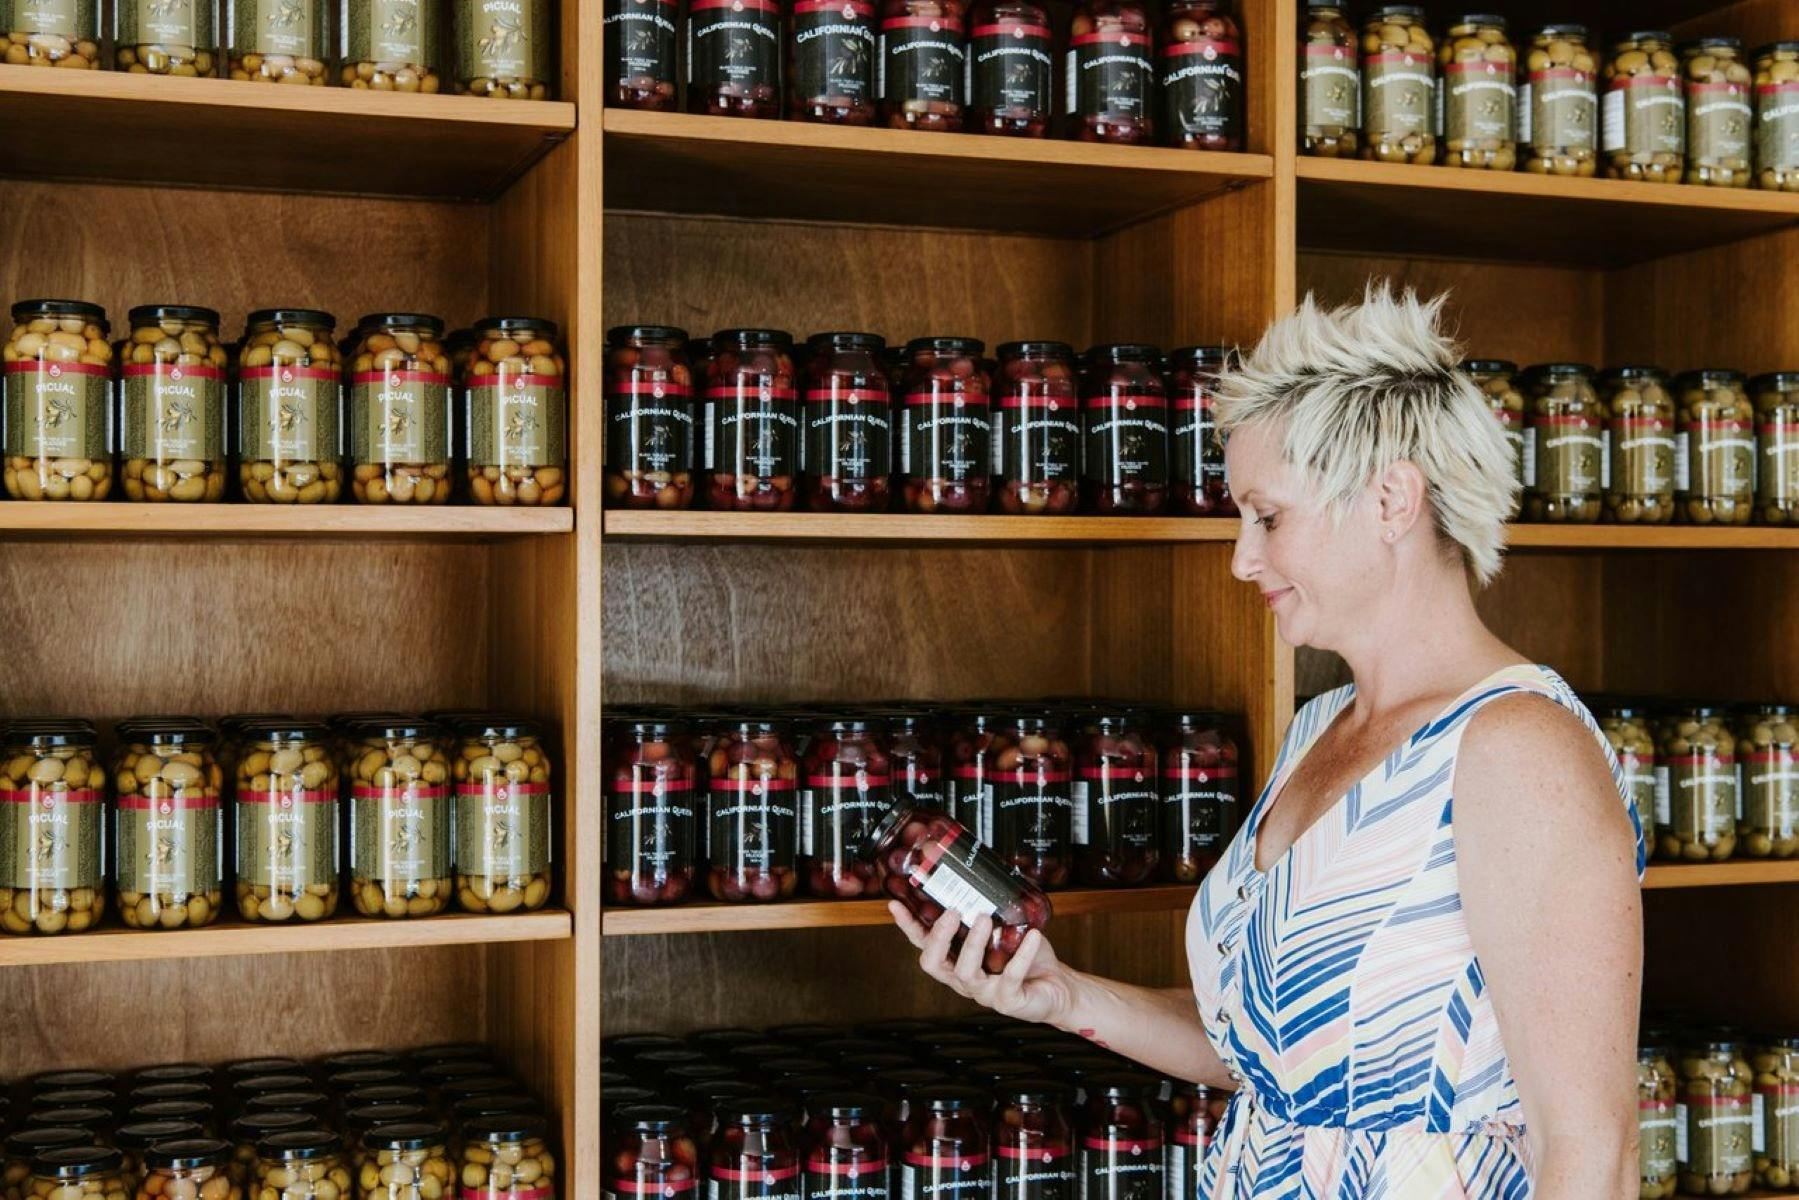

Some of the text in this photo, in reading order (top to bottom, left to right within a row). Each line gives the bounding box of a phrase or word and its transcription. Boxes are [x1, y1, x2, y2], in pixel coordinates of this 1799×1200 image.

[482, 1, 521, 13] PICUAL
[697, 21, 751, 37] CALIFORNIAN
[797, 24, 862, 43] CALIFORNIAN
[892, 40, 946, 55] CALIFORNIAN
[1083, 55, 1136, 70] CALIFORNIAN
[1163, 64, 1224, 86] CALIFORNIAN
[36, 383, 75, 395] PICUAL
[155, 385, 195, 398] PICUAL
[269, 387, 306, 399] PICUAL
[378, 391, 414, 402] PICUAL
[501, 395, 538, 406] PICUAL
[615, 407, 671, 421] CALIFORNIAN
[721, 410, 778, 425] CALIFORNIAN
[811, 413, 866, 428] CALIFORNIAN
[917, 416, 972, 431] CALIFORNIAN
[1091, 419, 1143, 434] CALIFORNIAN
[821, 801, 876, 814] CALIFORNIAN
[1000, 796, 1053, 808] CALIFORNIAN
[386, 808, 424, 820] PICUAL
[485, 804, 520, 816] PICUAL
[614, 805, 670, 820] CALIFORNIAN
[715, 805, 770, 817] CALIFORNIAN
[29, 813, 68, 825] PICUAL
[147, 819, 185, 831] PICUAL
[268, 813, 305, 825] PICUAL
[1094, 1164, 1148, 1175] CALIFORNIAN
[1005, 1172, 1059, 1185] CALIFORNIAN
[811, 1187, 866, 1199] CALIFORNIAN
[923, 1180, 977, 1193] CALIFORNIAN
